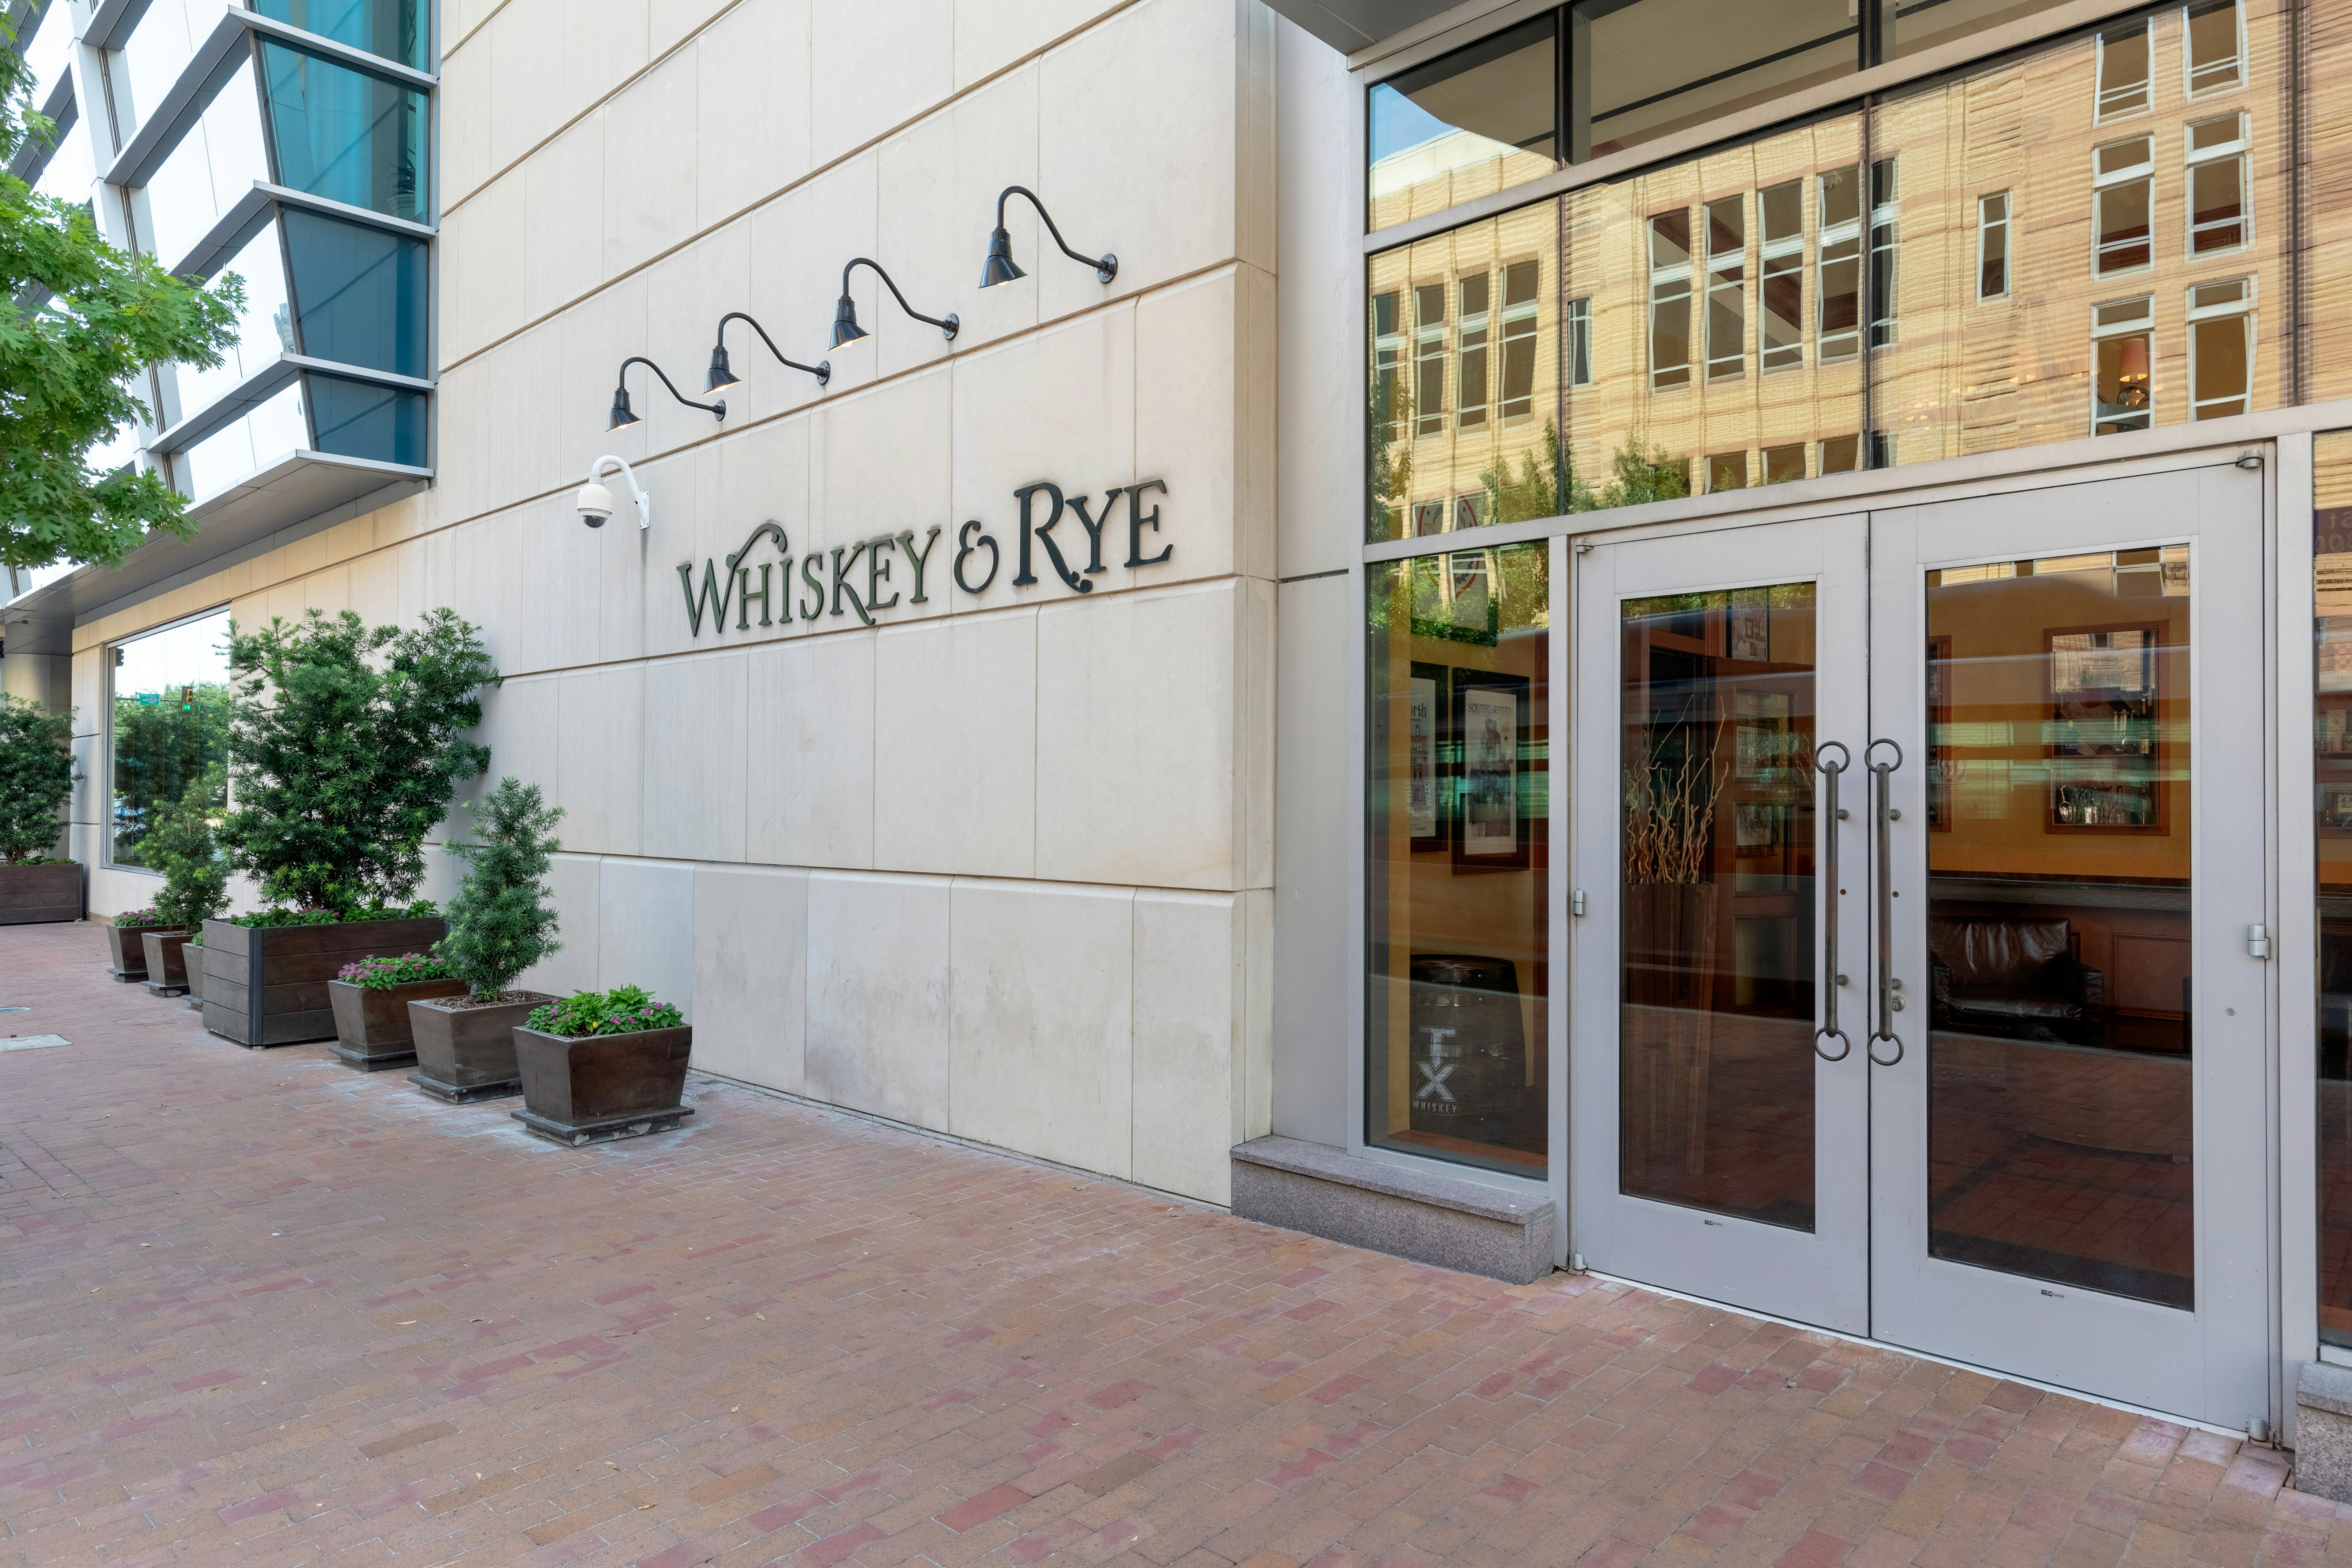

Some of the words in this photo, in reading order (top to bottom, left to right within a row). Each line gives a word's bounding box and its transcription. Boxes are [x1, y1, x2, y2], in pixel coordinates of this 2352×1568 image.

[676, 521, 941, 637] WHISKEY
[953, 520, 999, 594] &
[1013, 479, 1174, 593] RYE
[1468, 703, 1513, 716] SOUTHSTERN
[1413, 1100, 1457, 1113] WHISKEY
